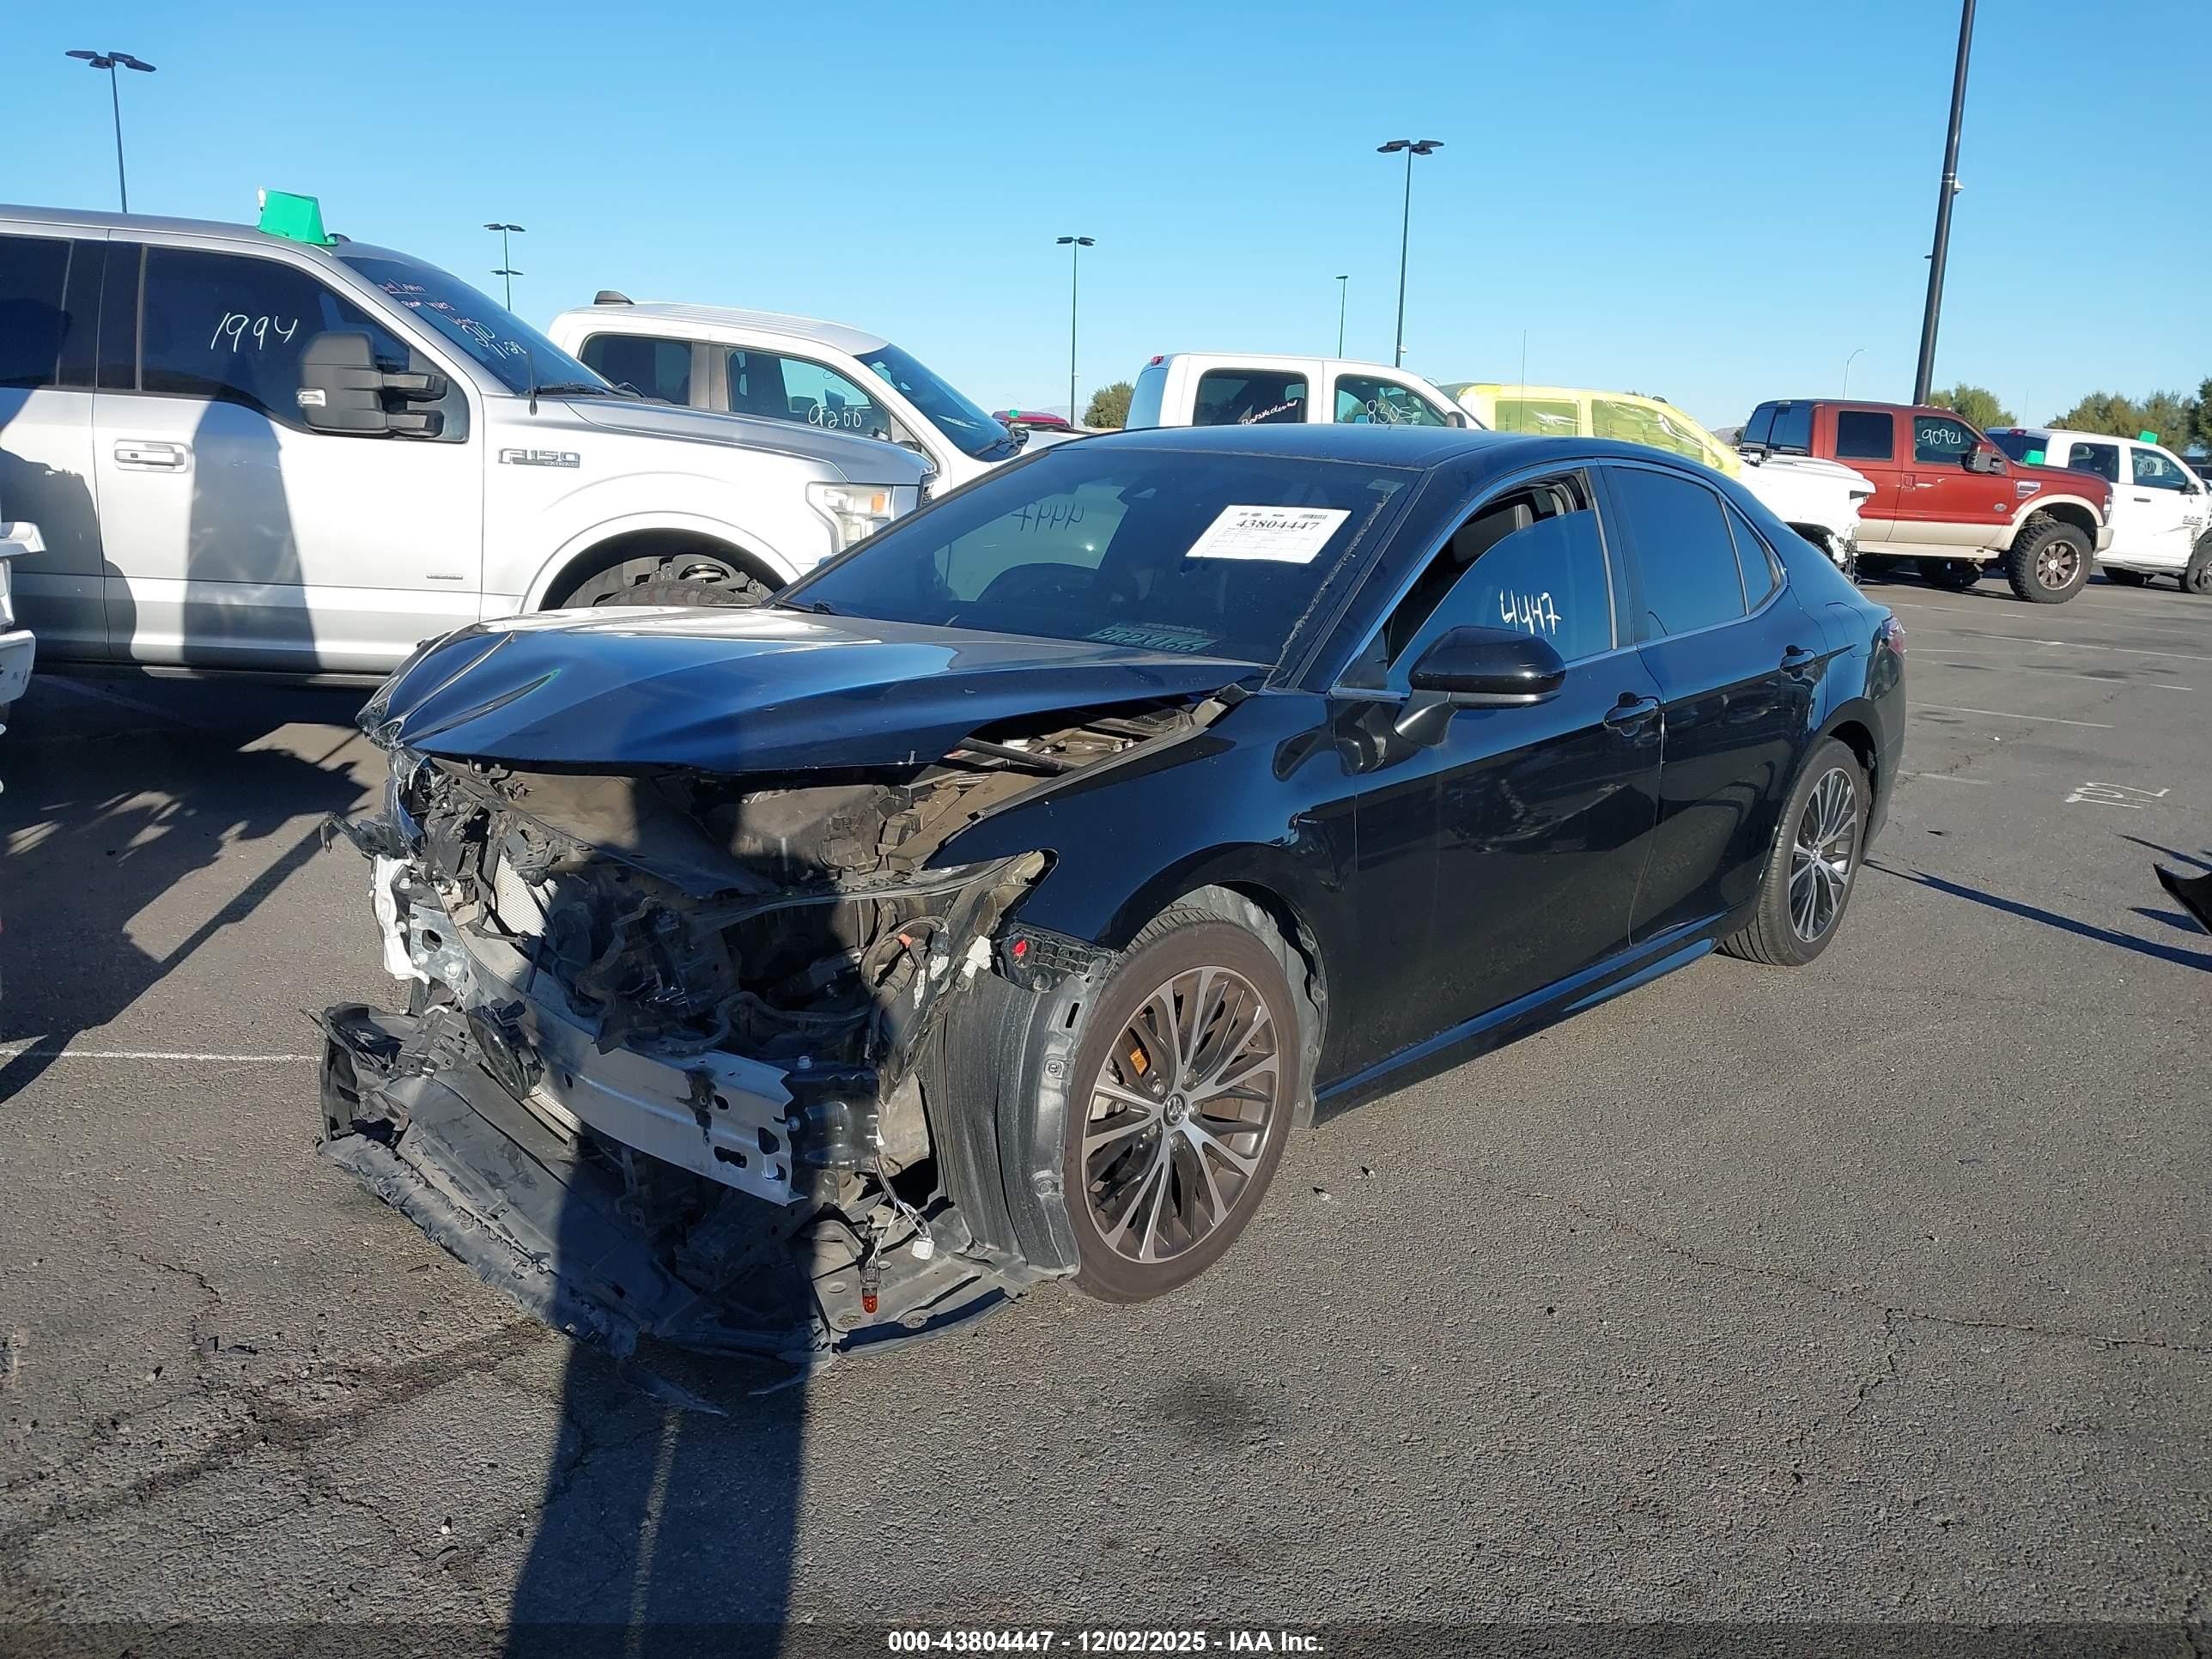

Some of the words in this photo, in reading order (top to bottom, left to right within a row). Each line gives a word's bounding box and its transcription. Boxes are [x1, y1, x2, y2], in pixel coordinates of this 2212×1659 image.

[210, 311, 299, 354] 1994
[1236, 519, 1321, 532] 43804447
[1499, 588, 1562, 636] 4447
